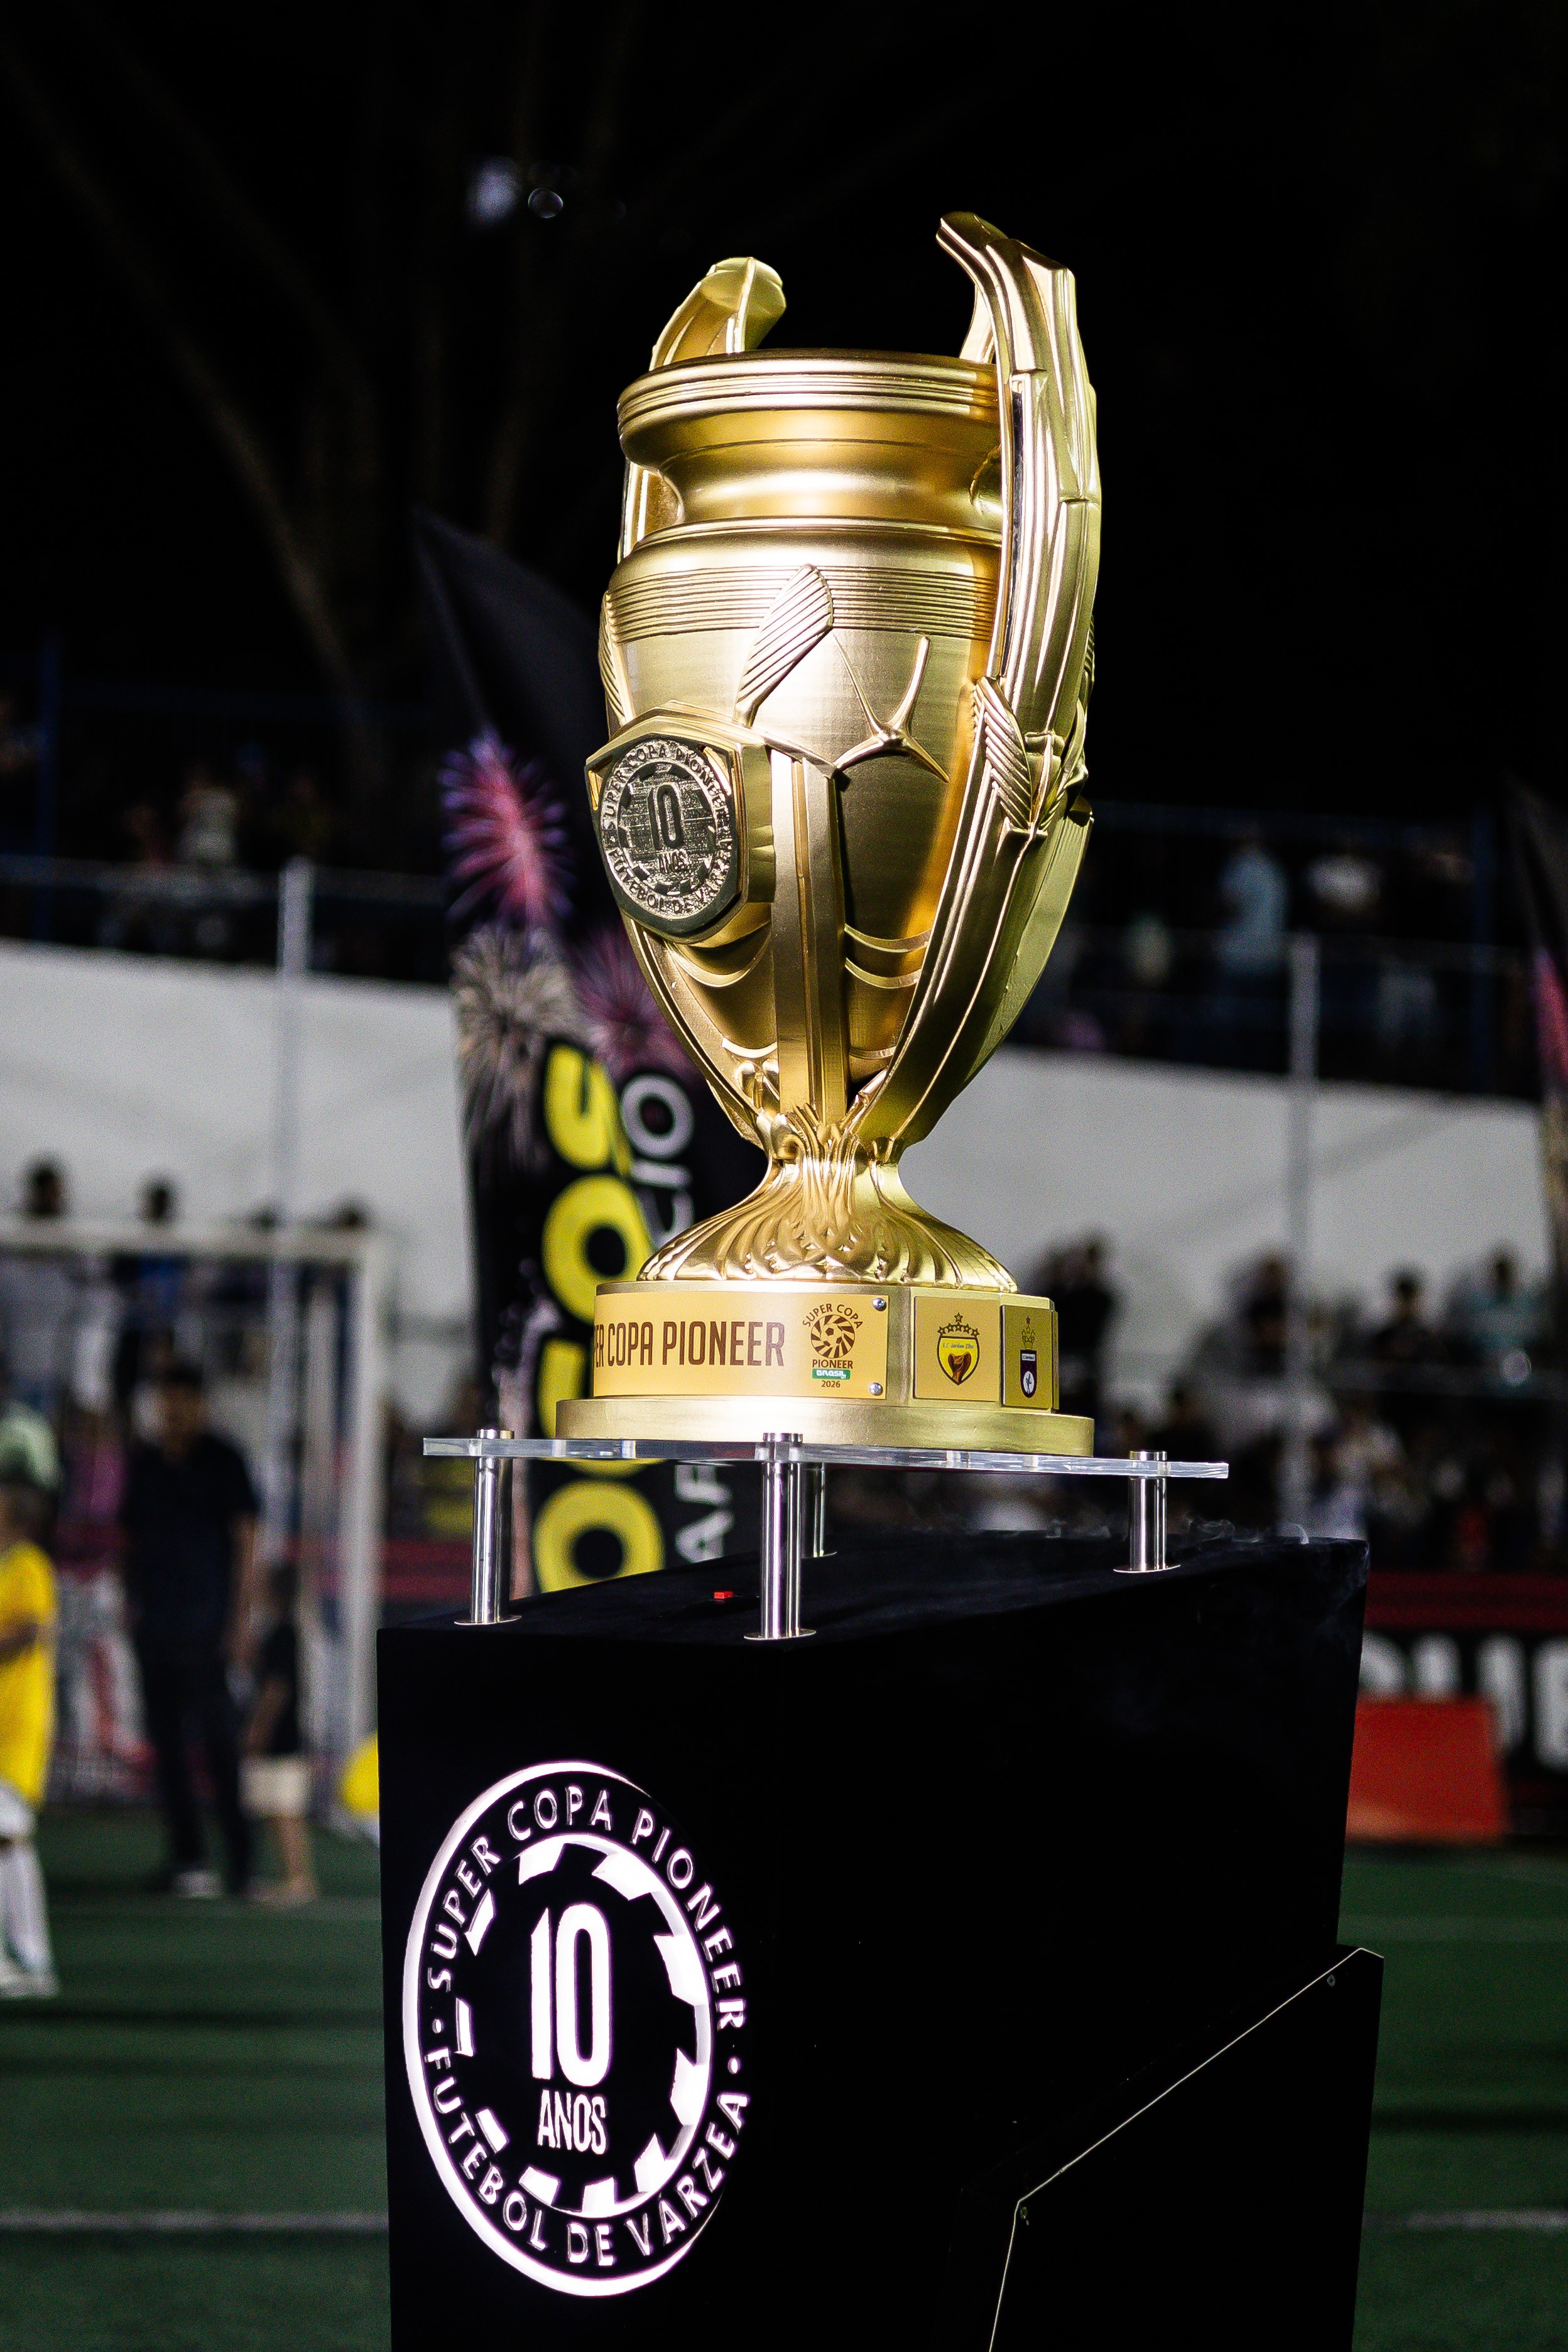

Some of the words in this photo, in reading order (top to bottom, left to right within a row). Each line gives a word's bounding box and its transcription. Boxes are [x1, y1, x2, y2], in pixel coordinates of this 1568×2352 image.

[627, 745, 667, 768] COPA
[647, 785, 684, 849] 10
[594, 1322, 604, 1368] ER
[607, 1321, 653, 1367] COPA
[662, 1320, 785, 1367] PIONEER
[803, 1303, 833, 1328] SUPER
[837, 1304, 864, 1329] COPA
[812, 1359, 854, 1369] PIONEER
[428, 1835, 501, 1993] SUPER
[507, 1784, 612, 1841] COPA
[631, 1808, 746, 2032] PIONEER
[530, 1901, 612, 2087] 10
[537, 2088, 607, 2155] ANOS
[423, 2047, 548, 2252] FUTEBOL
[566, 2221, 616, 2267] DE
